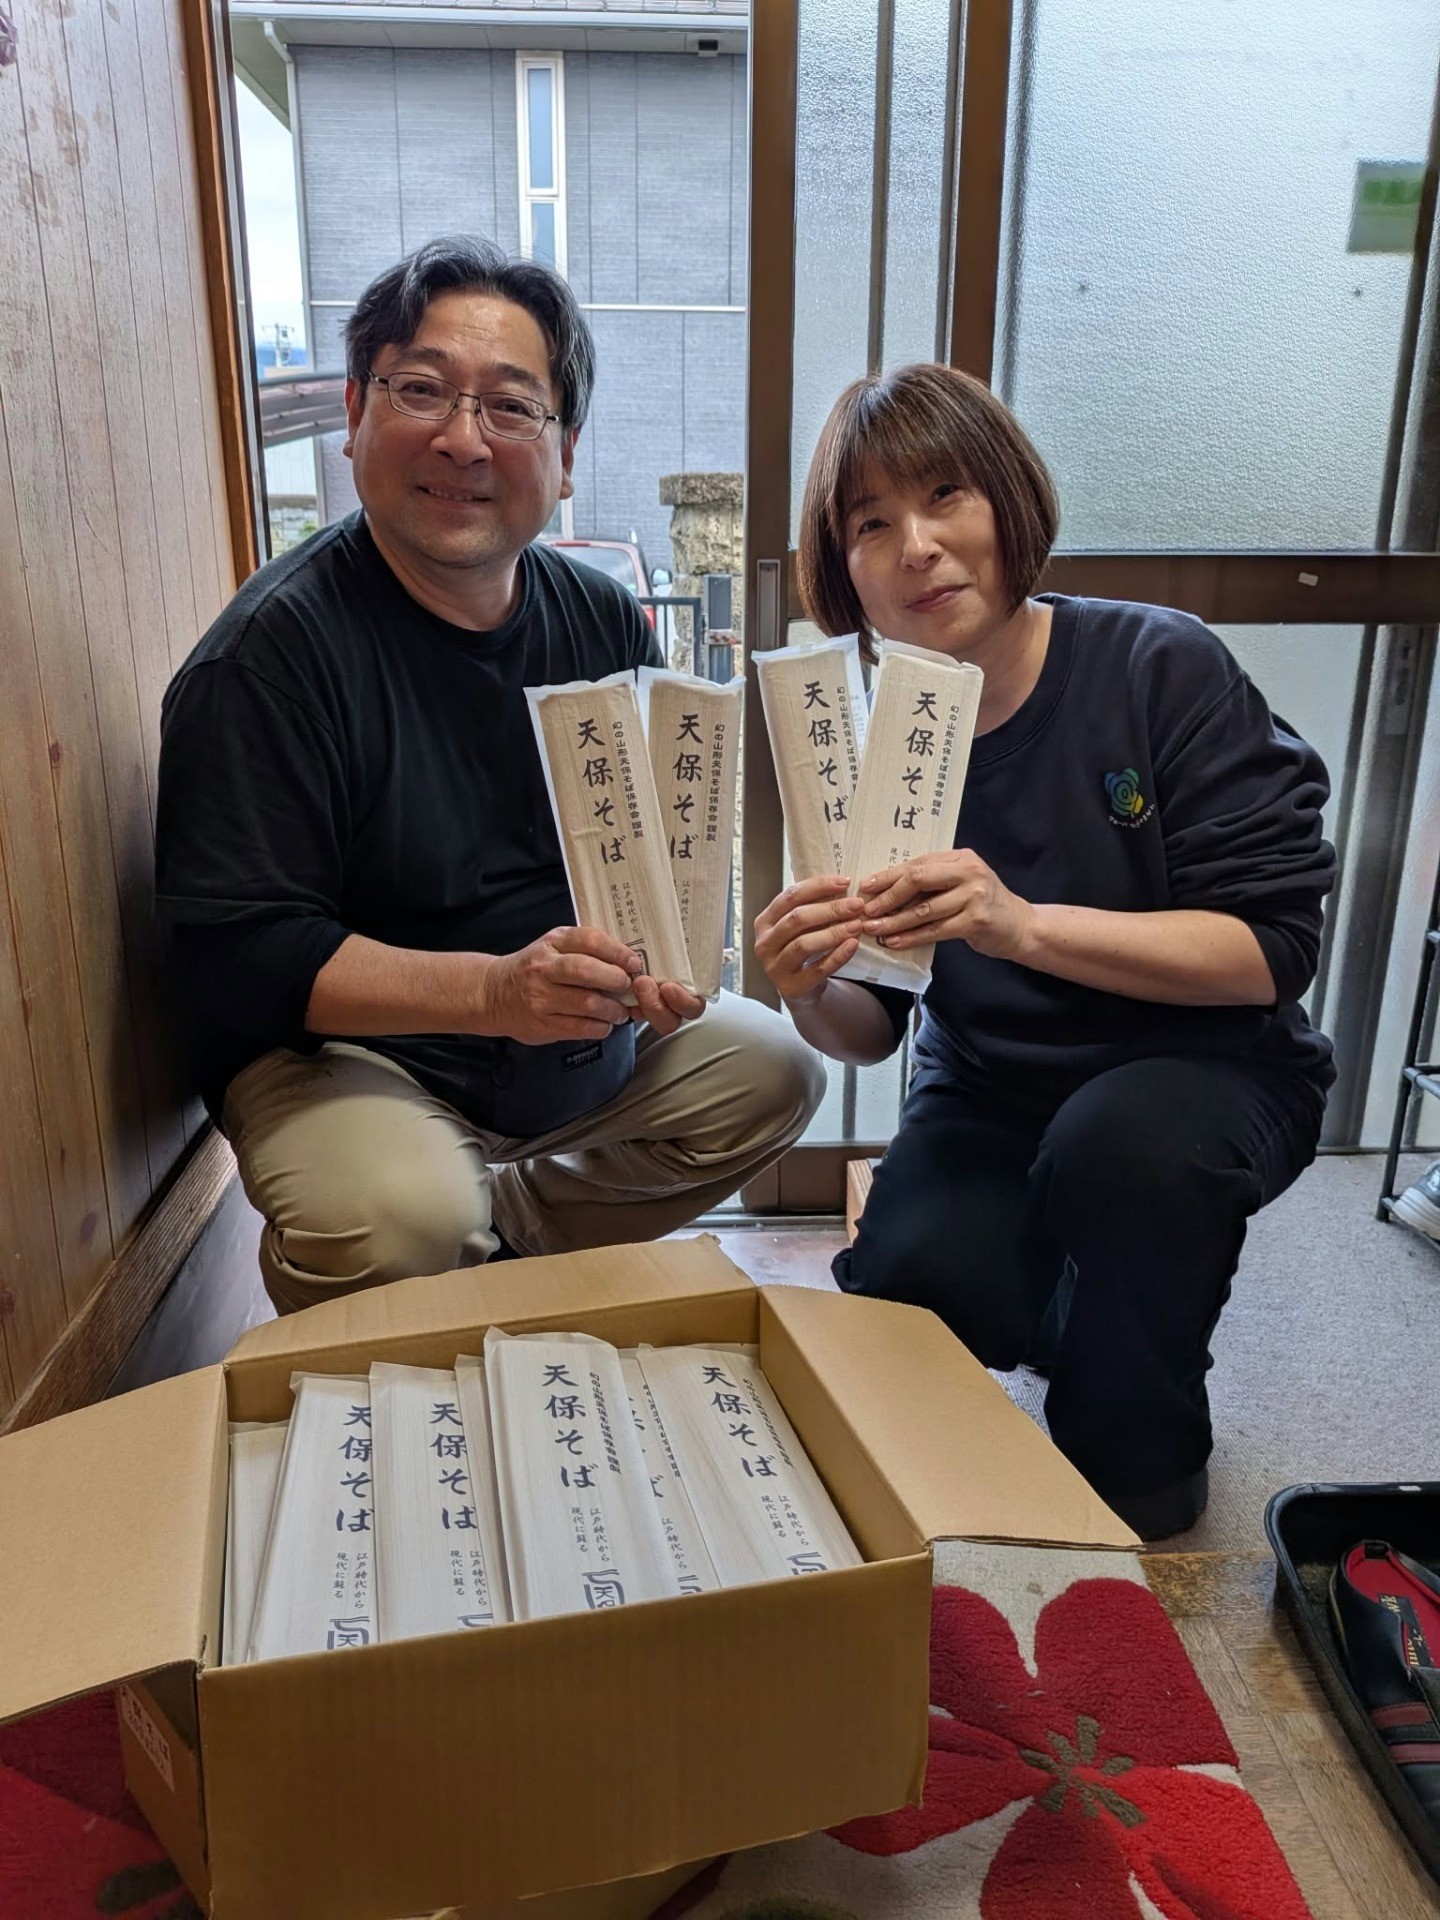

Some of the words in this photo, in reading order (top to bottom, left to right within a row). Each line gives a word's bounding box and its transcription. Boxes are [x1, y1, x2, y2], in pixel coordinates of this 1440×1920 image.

[577, 718, 626, 864] 天保そば
[670, 714, 703, 859] 天保そば
[804, 681, 848, 823] 天保そば
[893, 691, 938, 830] 天保そば
[623, 882, 638, 933] 江戸時代から
[336, 1405, 375, 1532] 天保そば
[429, 1403, 477, 1530] 天保そば
[542, 1365, 598, 1488] 天保そば
[702, 1366, 777, 1477] 天保そば
[470, 1550, 487, 1605] 江戸時代から
[590, 1507, 609, 1562] 江戸時代から
[662, 1518, 687, 1569] 江戸時代から
[779, 1495, 809, 1546] 江戸時代から
[354, 1552, 368, 1608] 江戸時代から
